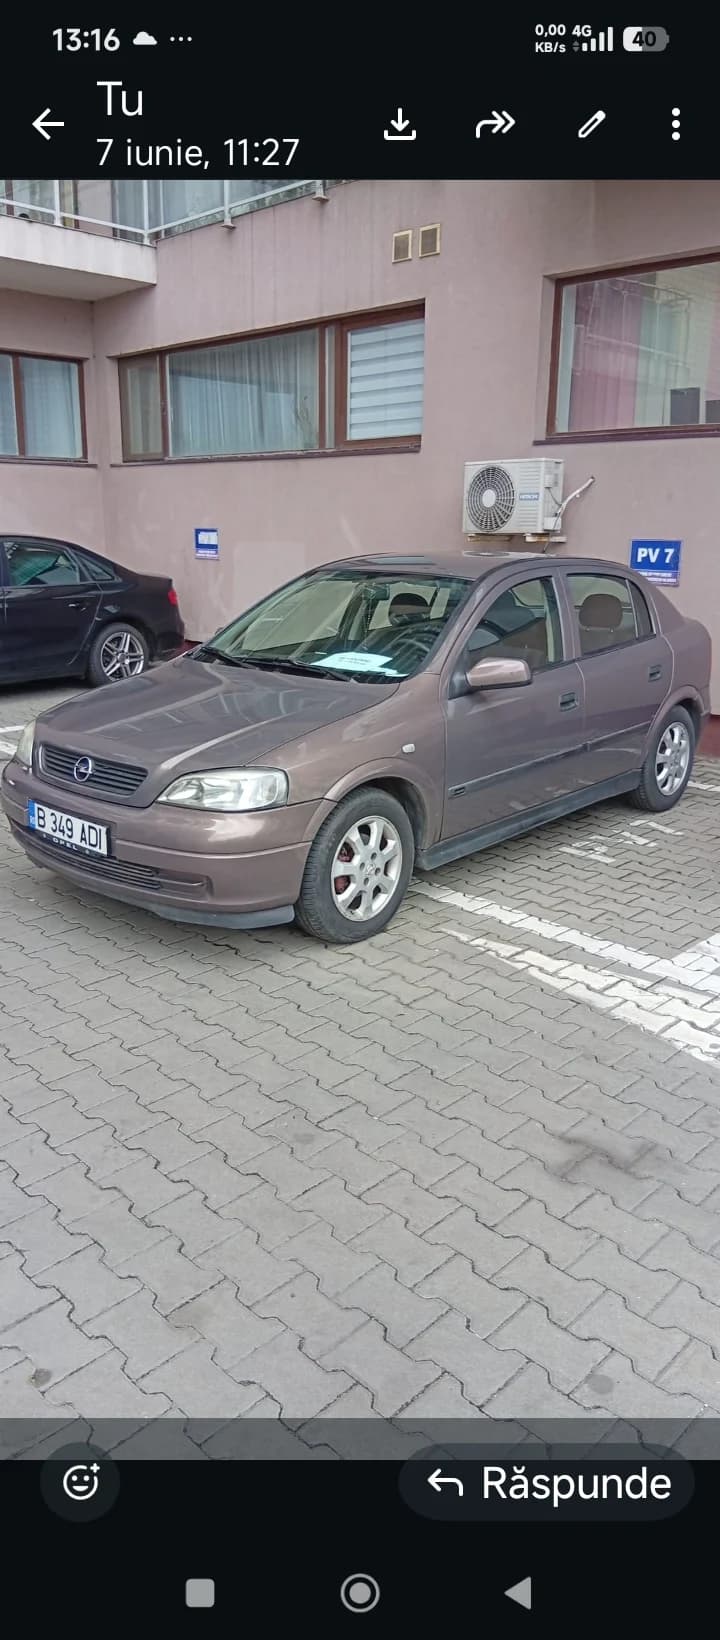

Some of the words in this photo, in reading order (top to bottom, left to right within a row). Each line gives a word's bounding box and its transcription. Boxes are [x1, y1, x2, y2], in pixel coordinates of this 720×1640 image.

[637, 548, 660, 563] PV
[664, 548, 675, 563] 7
[37, 807, 46, 828] B
[50, 812, 73, 839] 349
[80, 823, 102, 850] ADI
